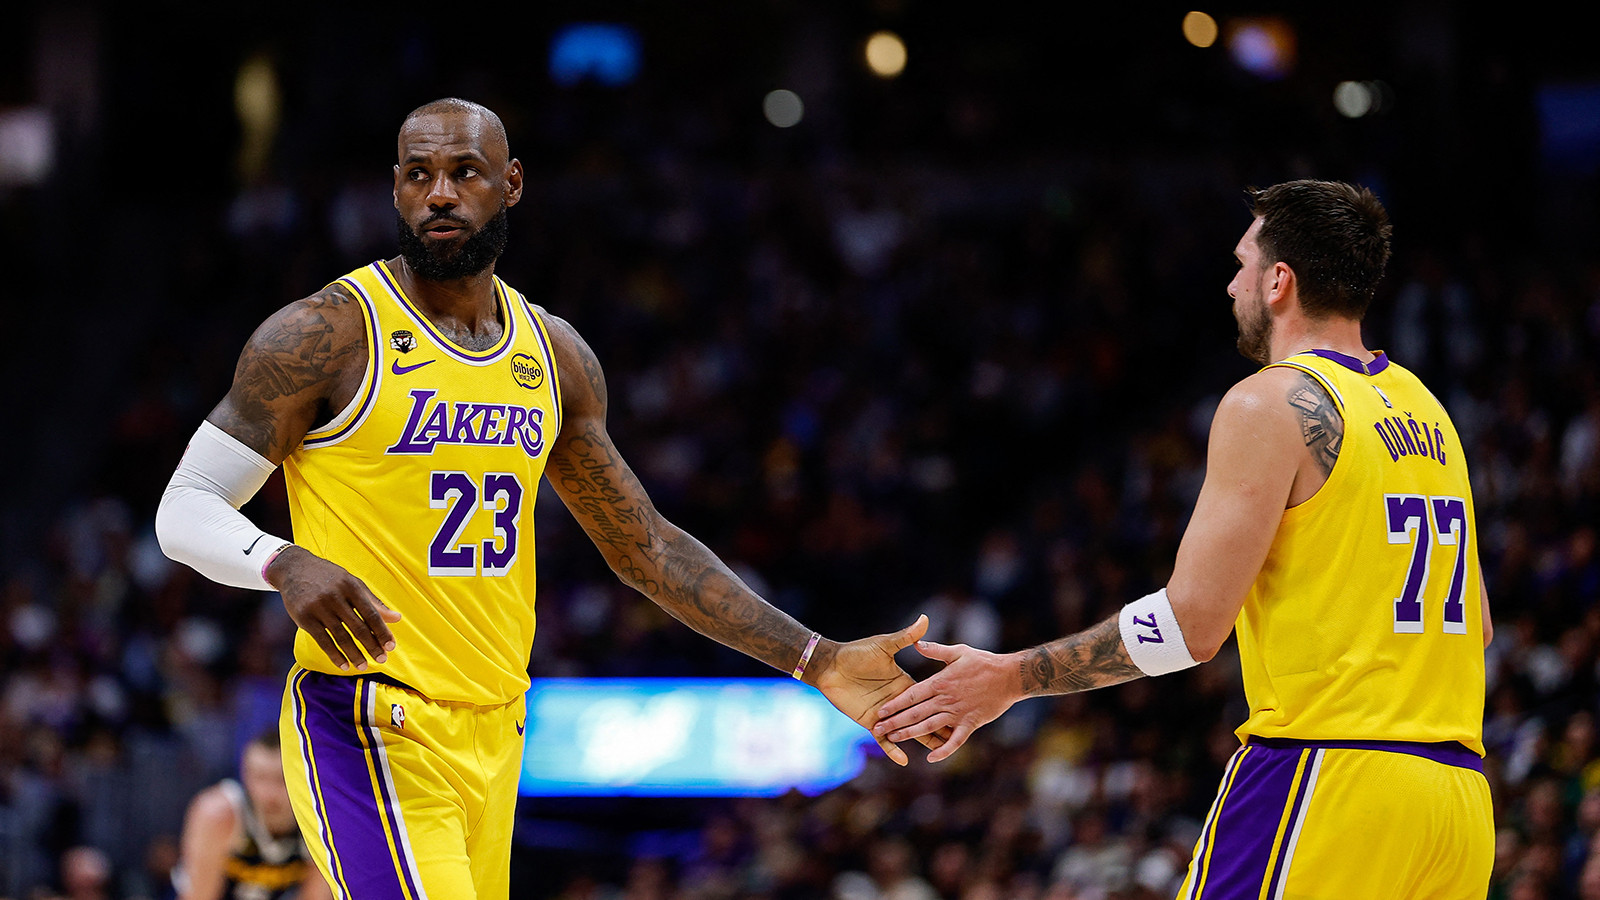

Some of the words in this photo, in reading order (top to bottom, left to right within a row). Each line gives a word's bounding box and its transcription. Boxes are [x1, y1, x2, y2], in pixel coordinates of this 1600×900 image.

[513, 361, 541, 380] bibigo
[384, 388, 545, 459] LAKERS
[1374, 410, 1446, 466] DONČIĆ
[428, 471, 525, 577] 23
[1383, 493, 1468, 635] 77
[1133, 612, 1164, 644] 77
